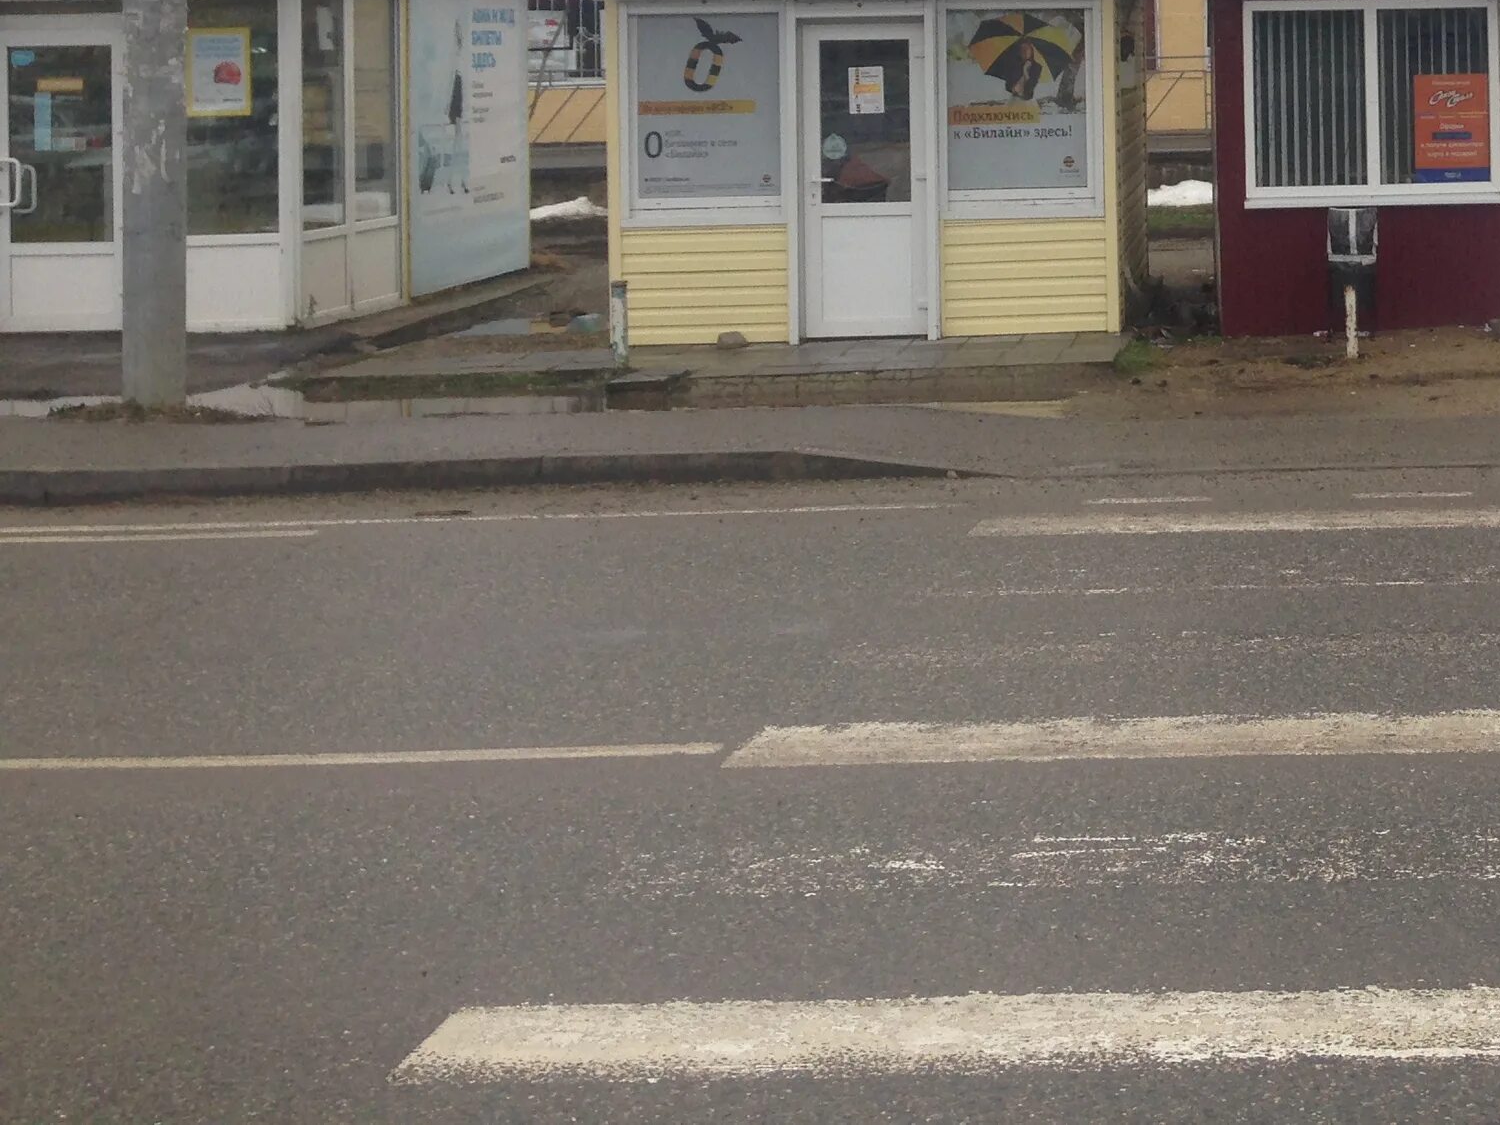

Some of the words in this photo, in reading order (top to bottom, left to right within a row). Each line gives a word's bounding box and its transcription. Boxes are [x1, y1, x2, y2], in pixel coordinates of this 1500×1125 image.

[953, 109, 1035, 124] Подключись
[953, 130, 961, 140] к
[1034, 125, 1073, 140] здесь!
